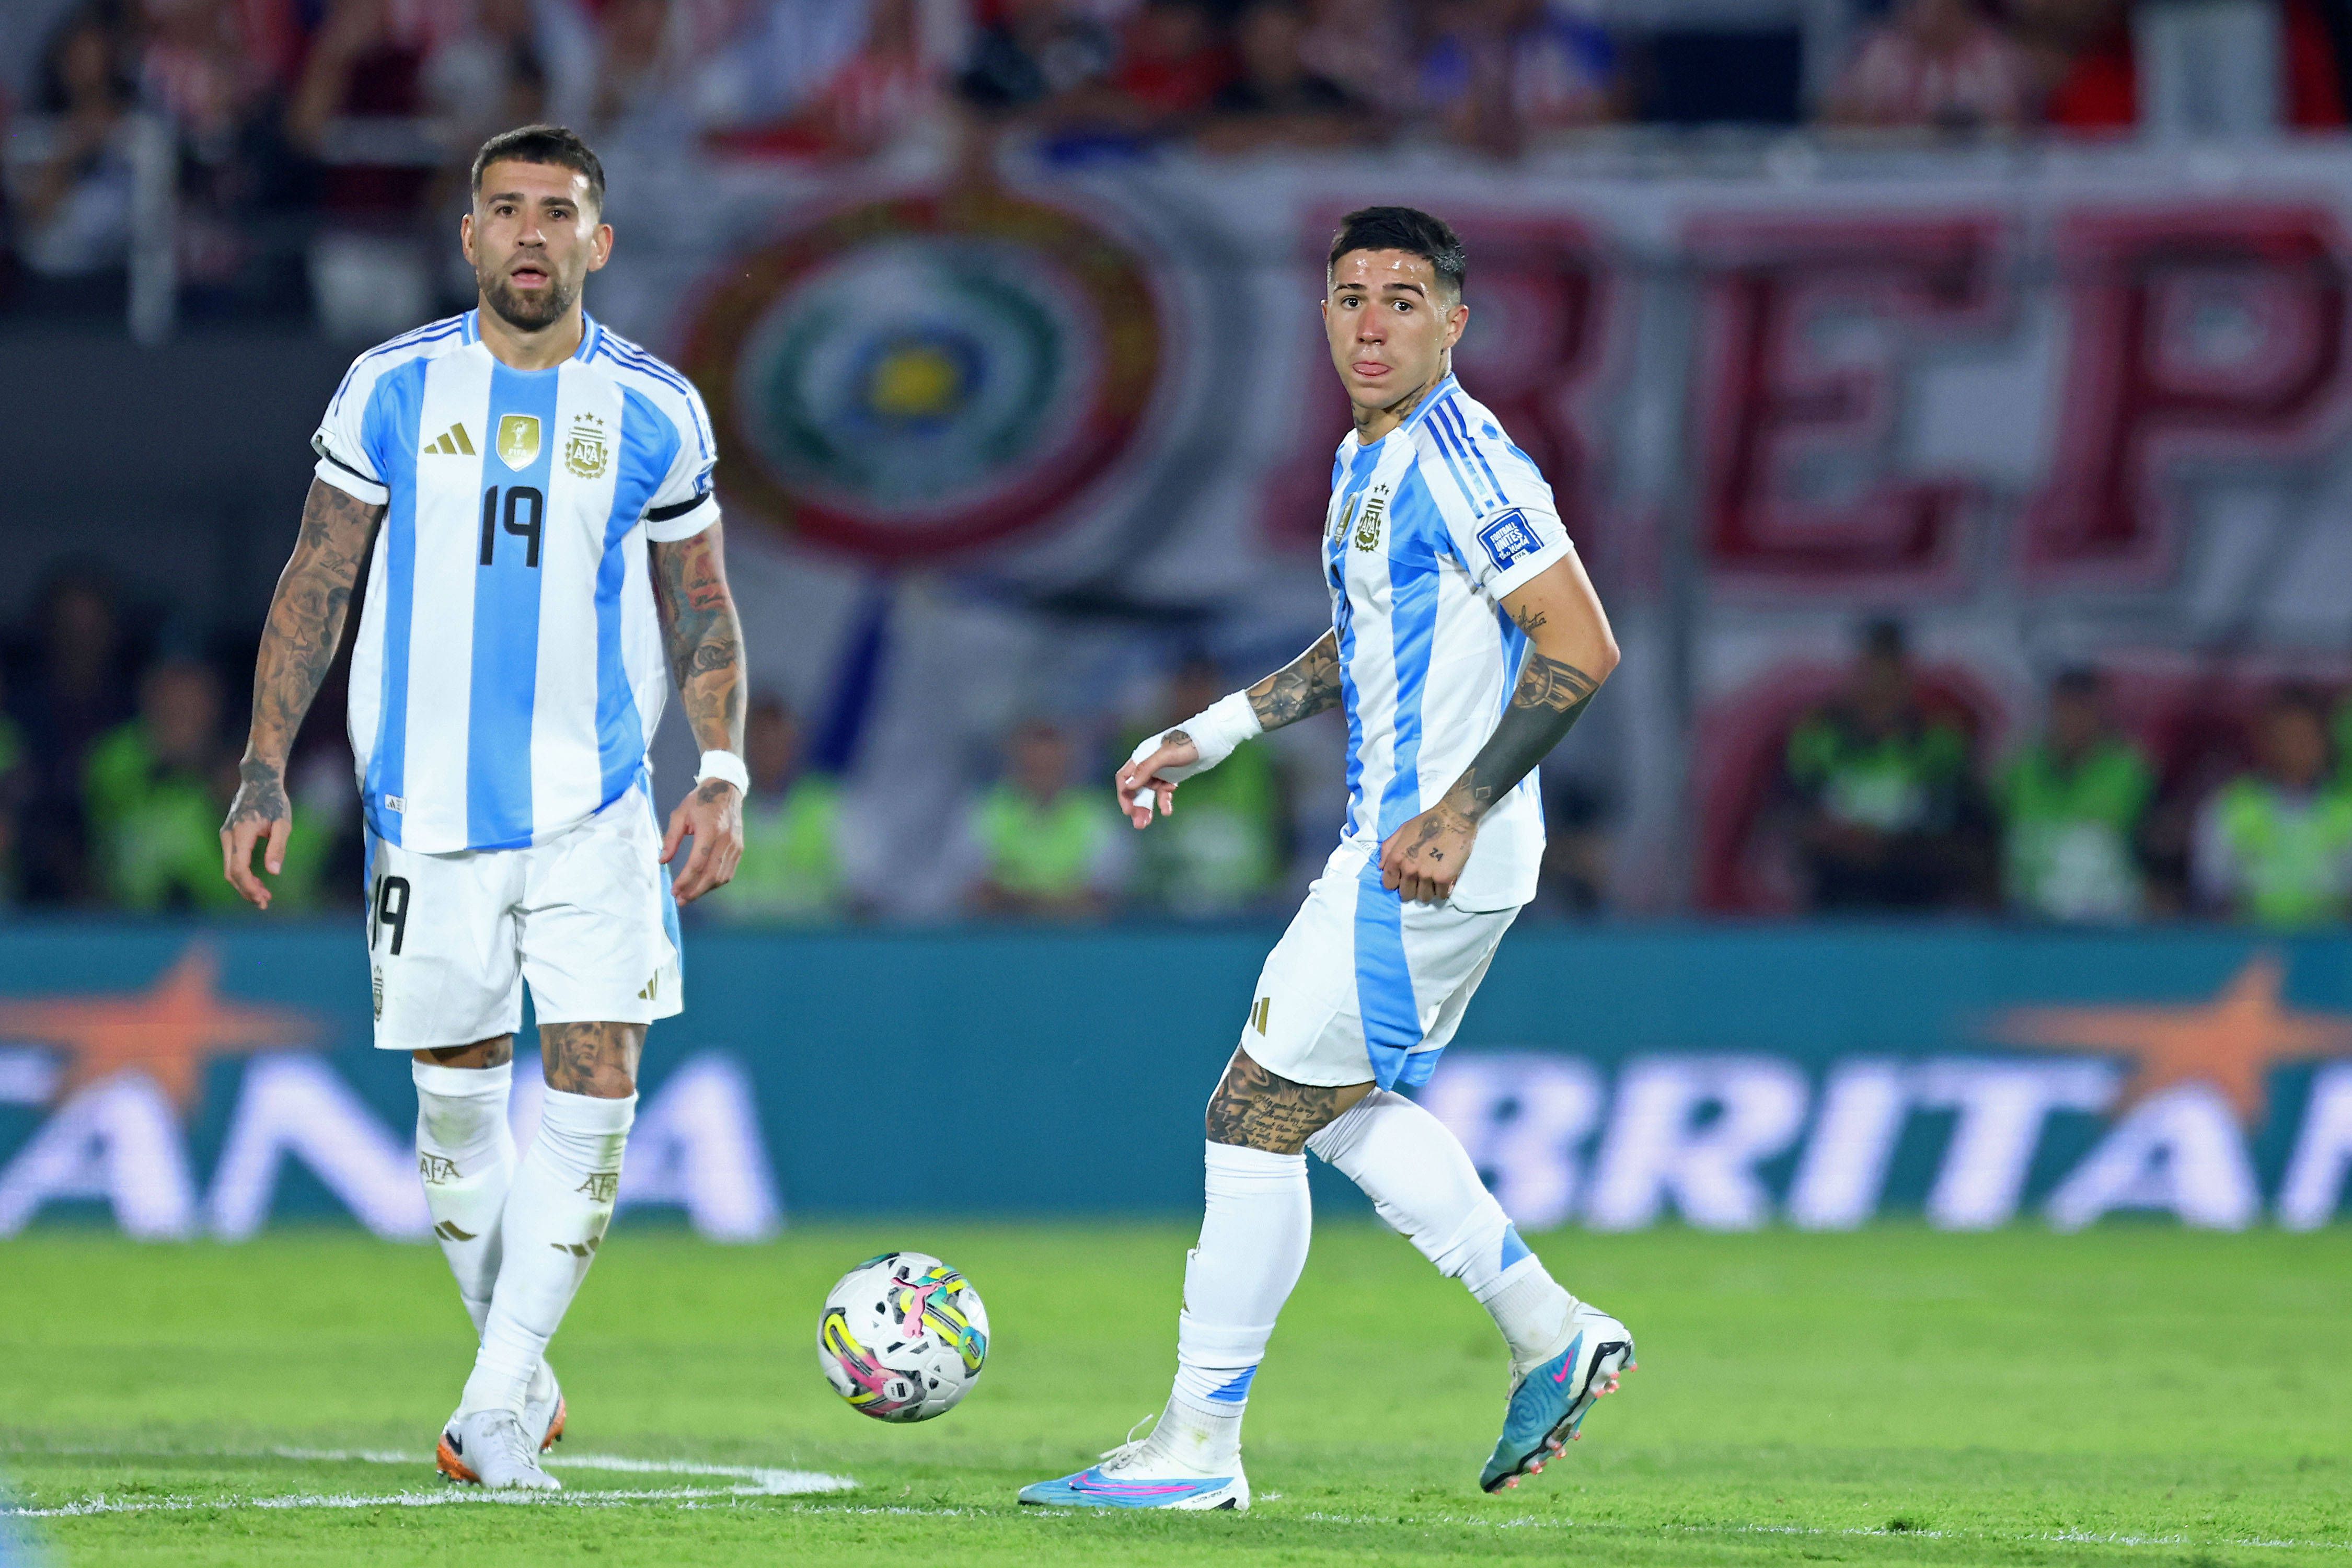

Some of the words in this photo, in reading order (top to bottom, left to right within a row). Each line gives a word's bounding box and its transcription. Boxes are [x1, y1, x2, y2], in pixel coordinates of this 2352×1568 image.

[573, 440, 599, 465] AFA
[480, 485, 542, 567] 19
[1490, 522, 1518, 543] FOOTBALL
[1494, 529, 1523, 552] UNITES
[371, 874, 410, 955] 19
[1416, 1052, 2352, 1233] BRITA
[420, 1151, 463, 1185] AFA
